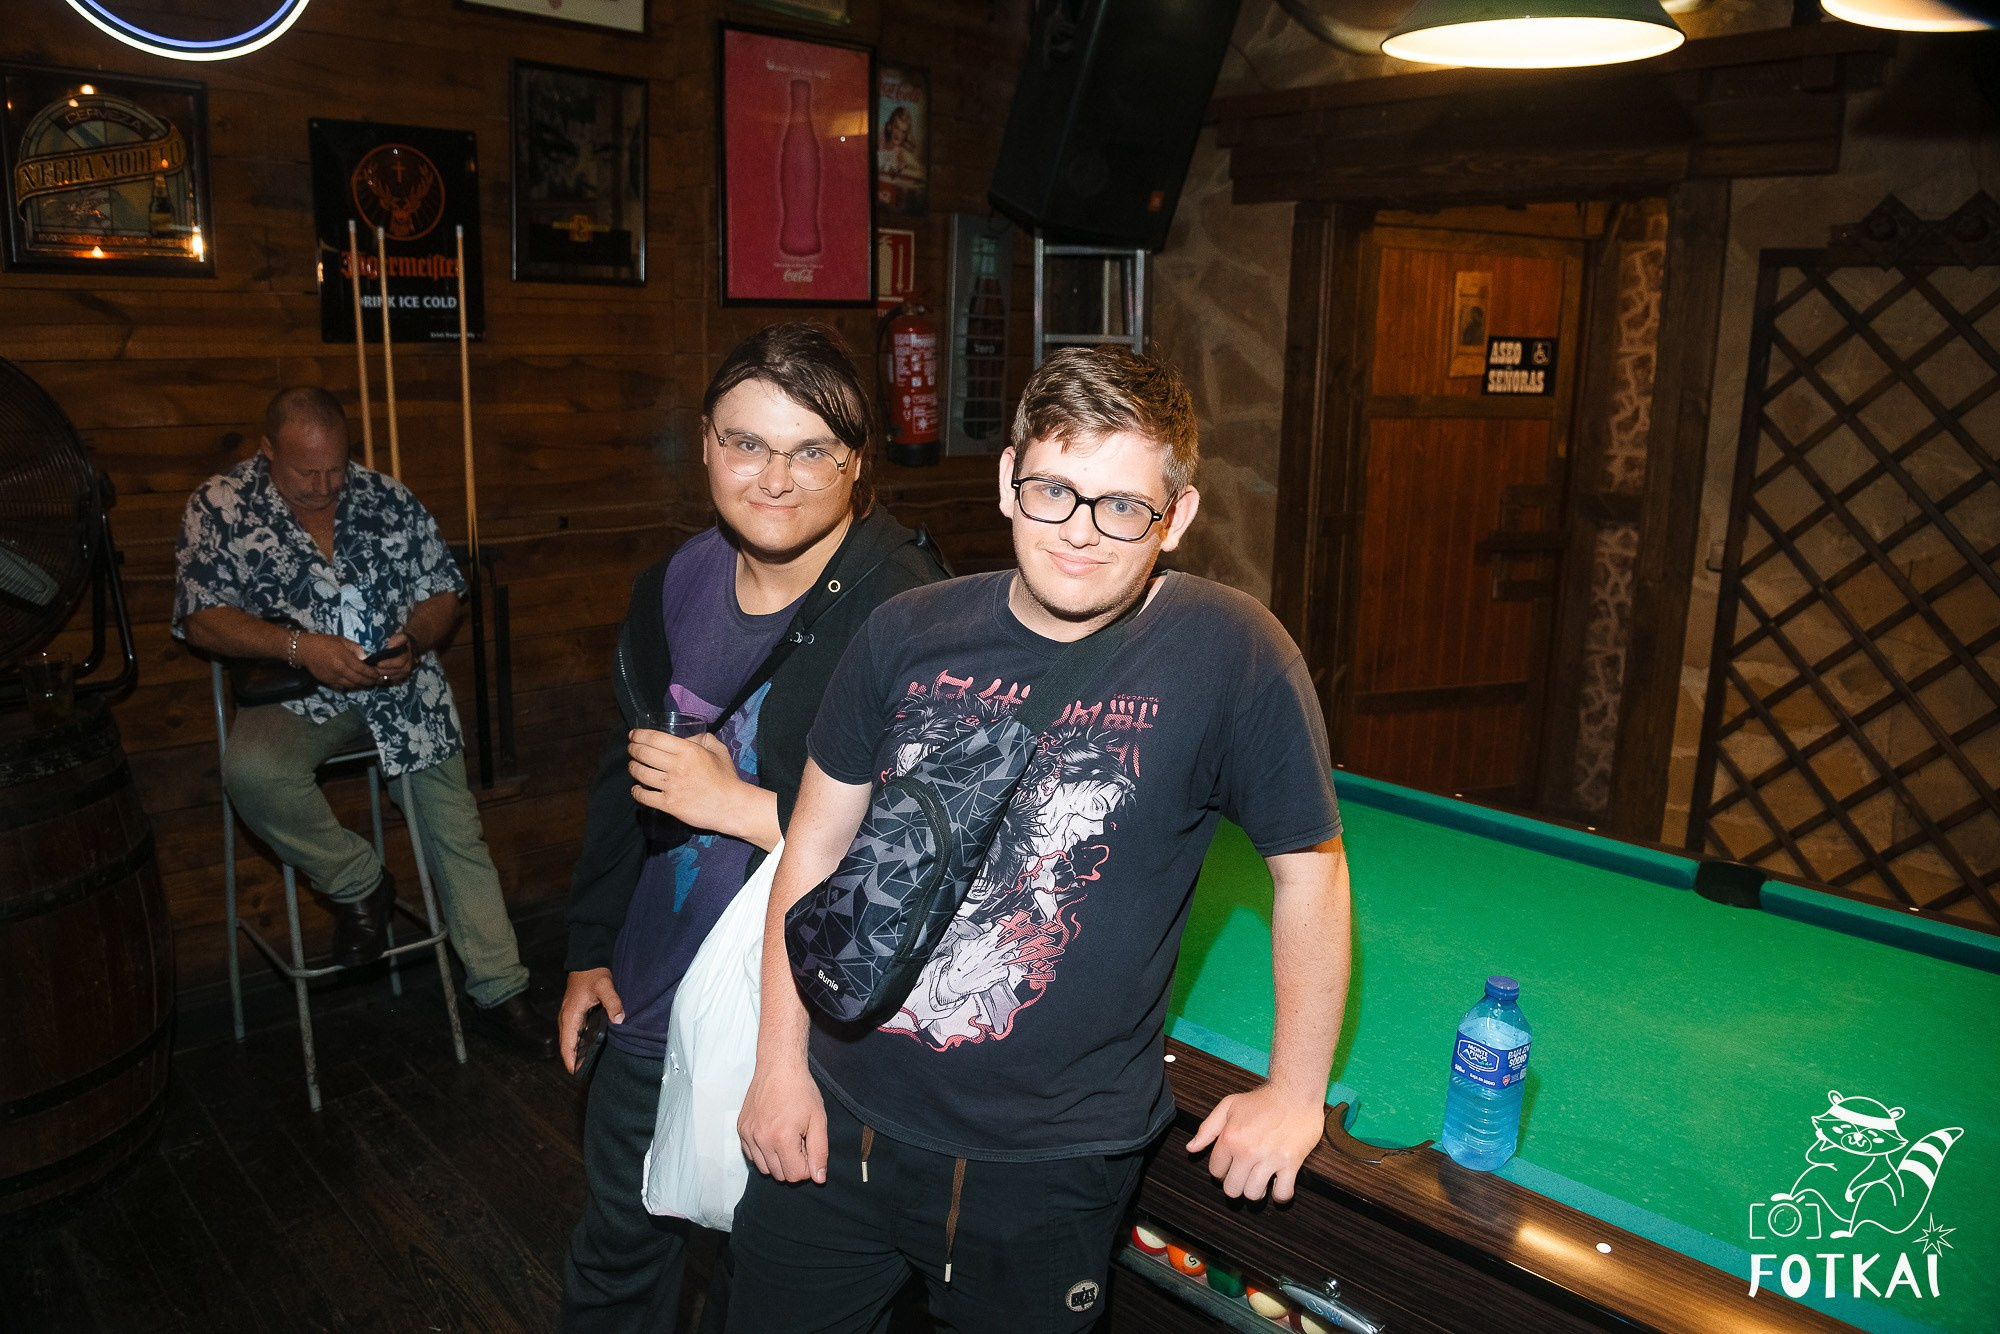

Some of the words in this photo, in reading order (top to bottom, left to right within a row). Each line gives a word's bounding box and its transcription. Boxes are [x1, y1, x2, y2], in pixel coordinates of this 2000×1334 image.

[65, 108, 142, 130] CERVEZA
[22, 157, 96, 188] NEGRA
[399, 295, 420, 308] ICE
[422, 296, 457, 309] COLD
[1489, 341, 1522, 365] ASEO
[1487, 365, 1545, 394] SEÑORAS
[817, 969, 839, 991] Bunie
[1468, 1044, 1489, 1057] MONTE
[1469, 1049, 1488, 1062] PINOS
[1188, 1255, 1198, 1266] 5
